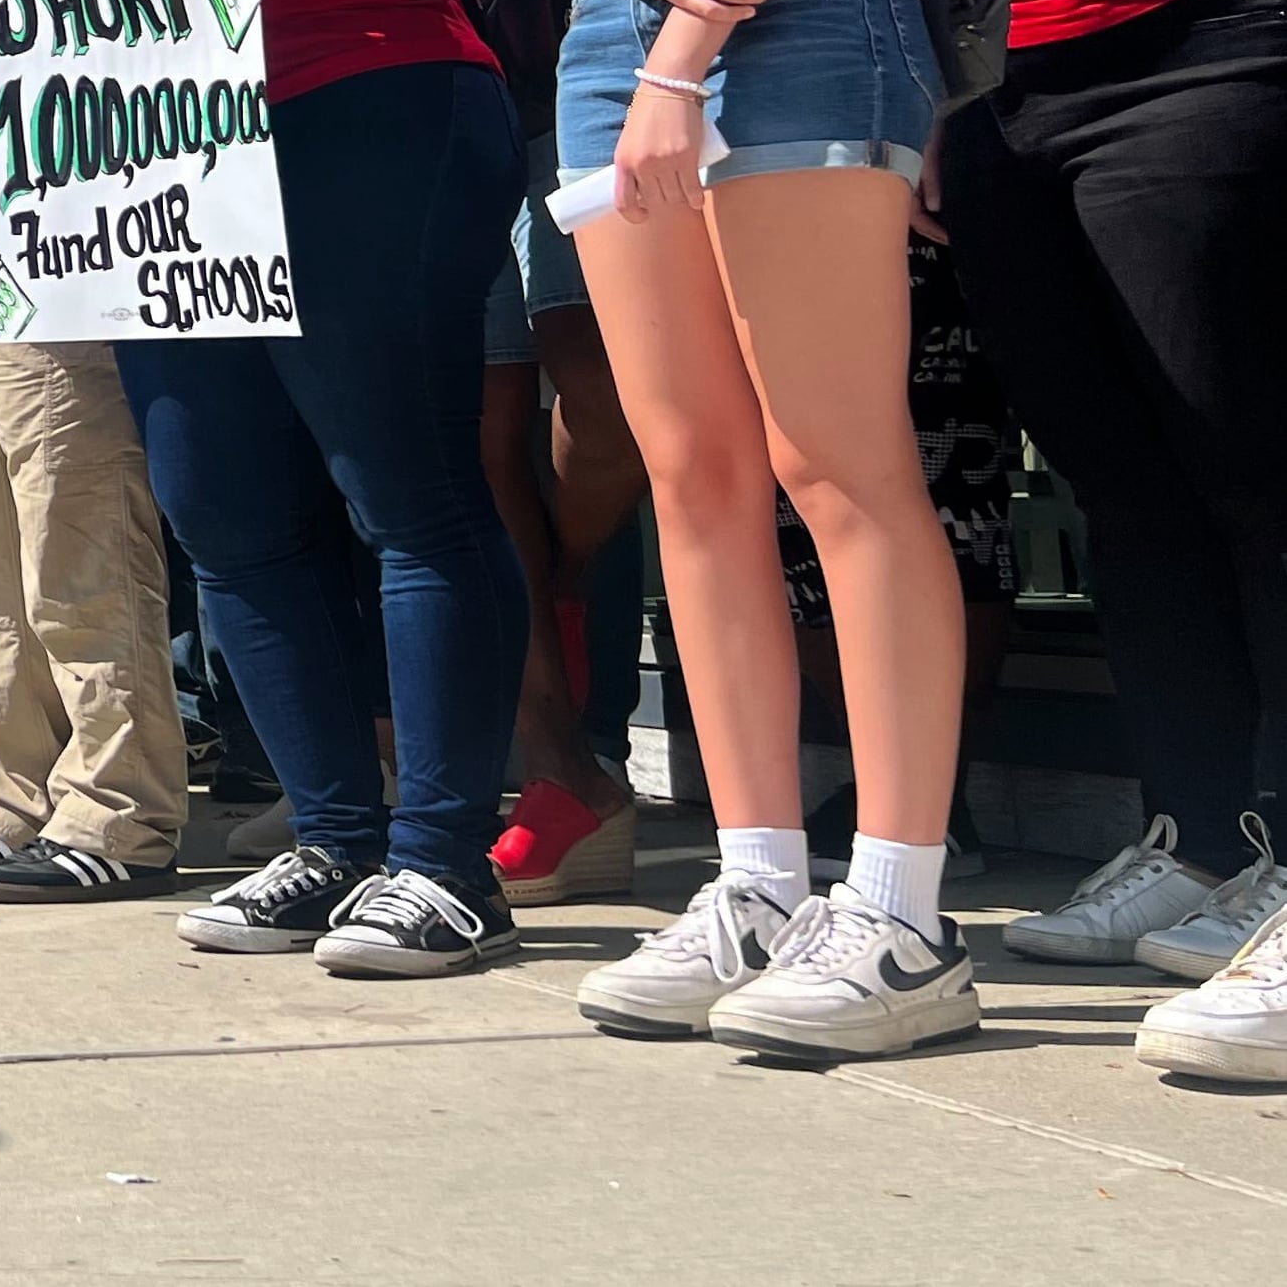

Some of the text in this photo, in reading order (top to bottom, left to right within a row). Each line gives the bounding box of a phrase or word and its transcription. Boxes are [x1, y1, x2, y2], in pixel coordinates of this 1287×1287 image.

[10, 205, 114, 280] Fund
[117, 183, 202, 259] OUR
[137, 254, 293, 332] SCHOOLS
